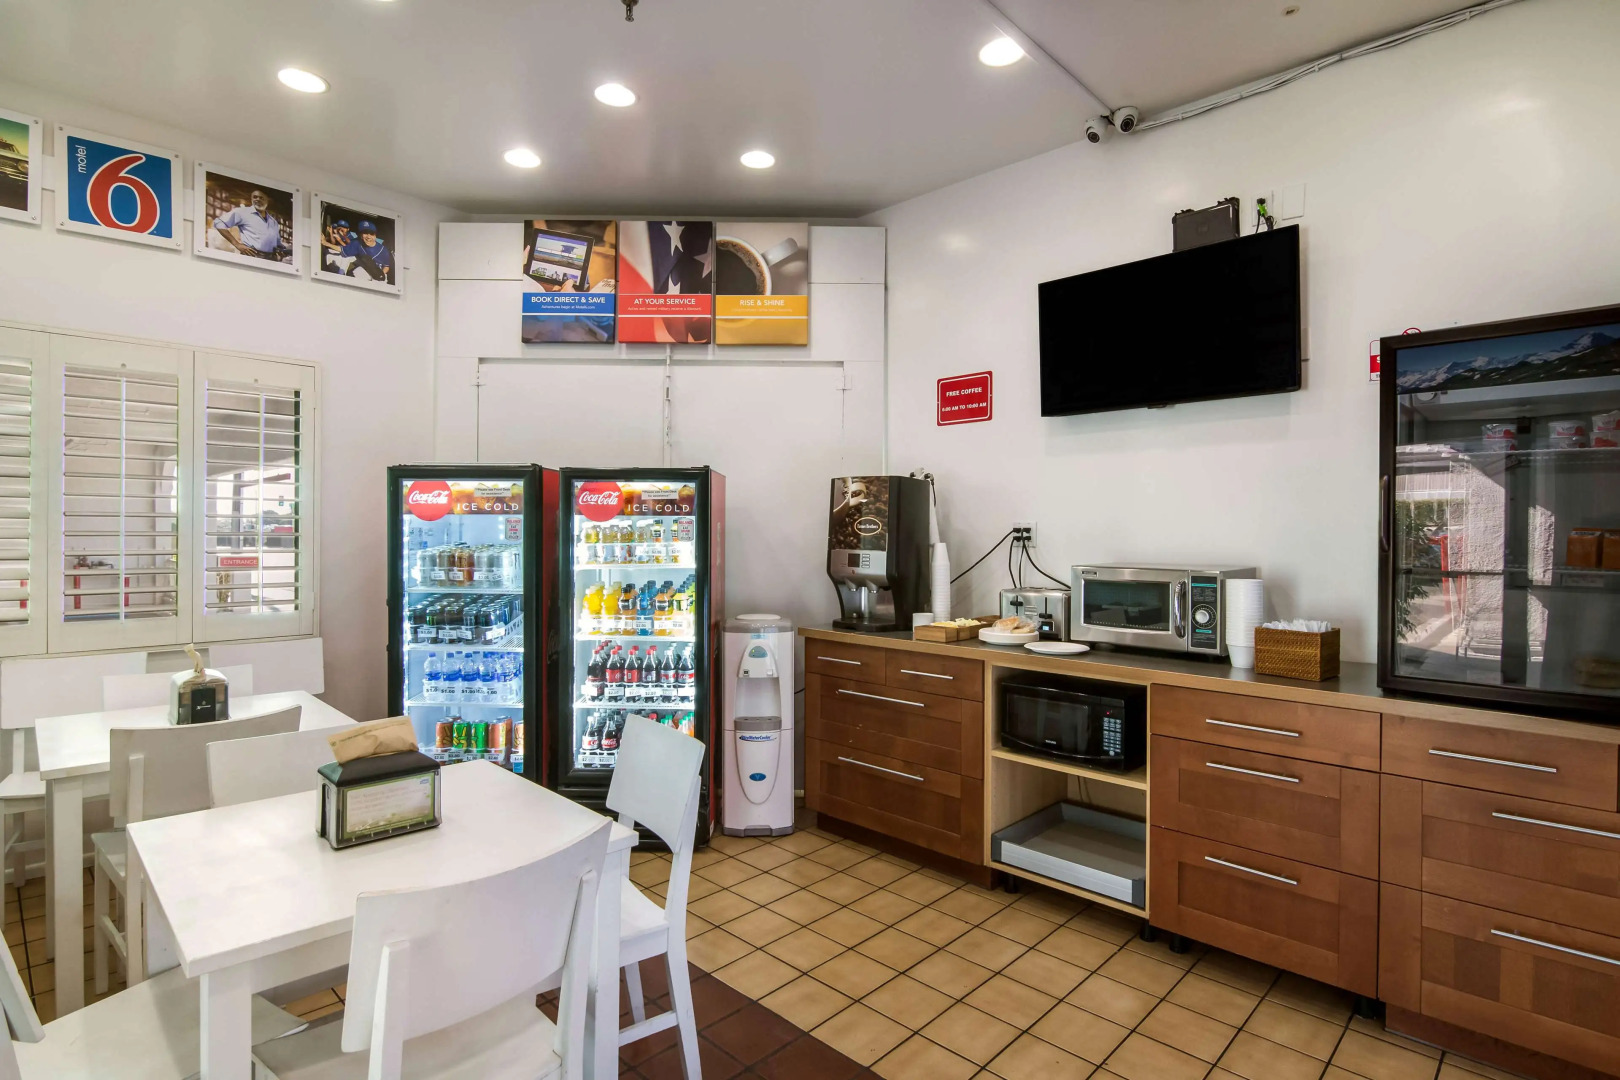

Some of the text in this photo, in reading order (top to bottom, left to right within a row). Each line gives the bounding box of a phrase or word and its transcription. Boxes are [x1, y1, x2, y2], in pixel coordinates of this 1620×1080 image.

[75, 144, 87, 174] motel
[86, 153, 160, 235] 6
[408, 490, 451, 505] Coca-Cola
[578, 491, 621, 506] Coca-Cola
[456, 502, 519, 512] ICE COLD
[627, 504, 690, 512] ICE COLD
